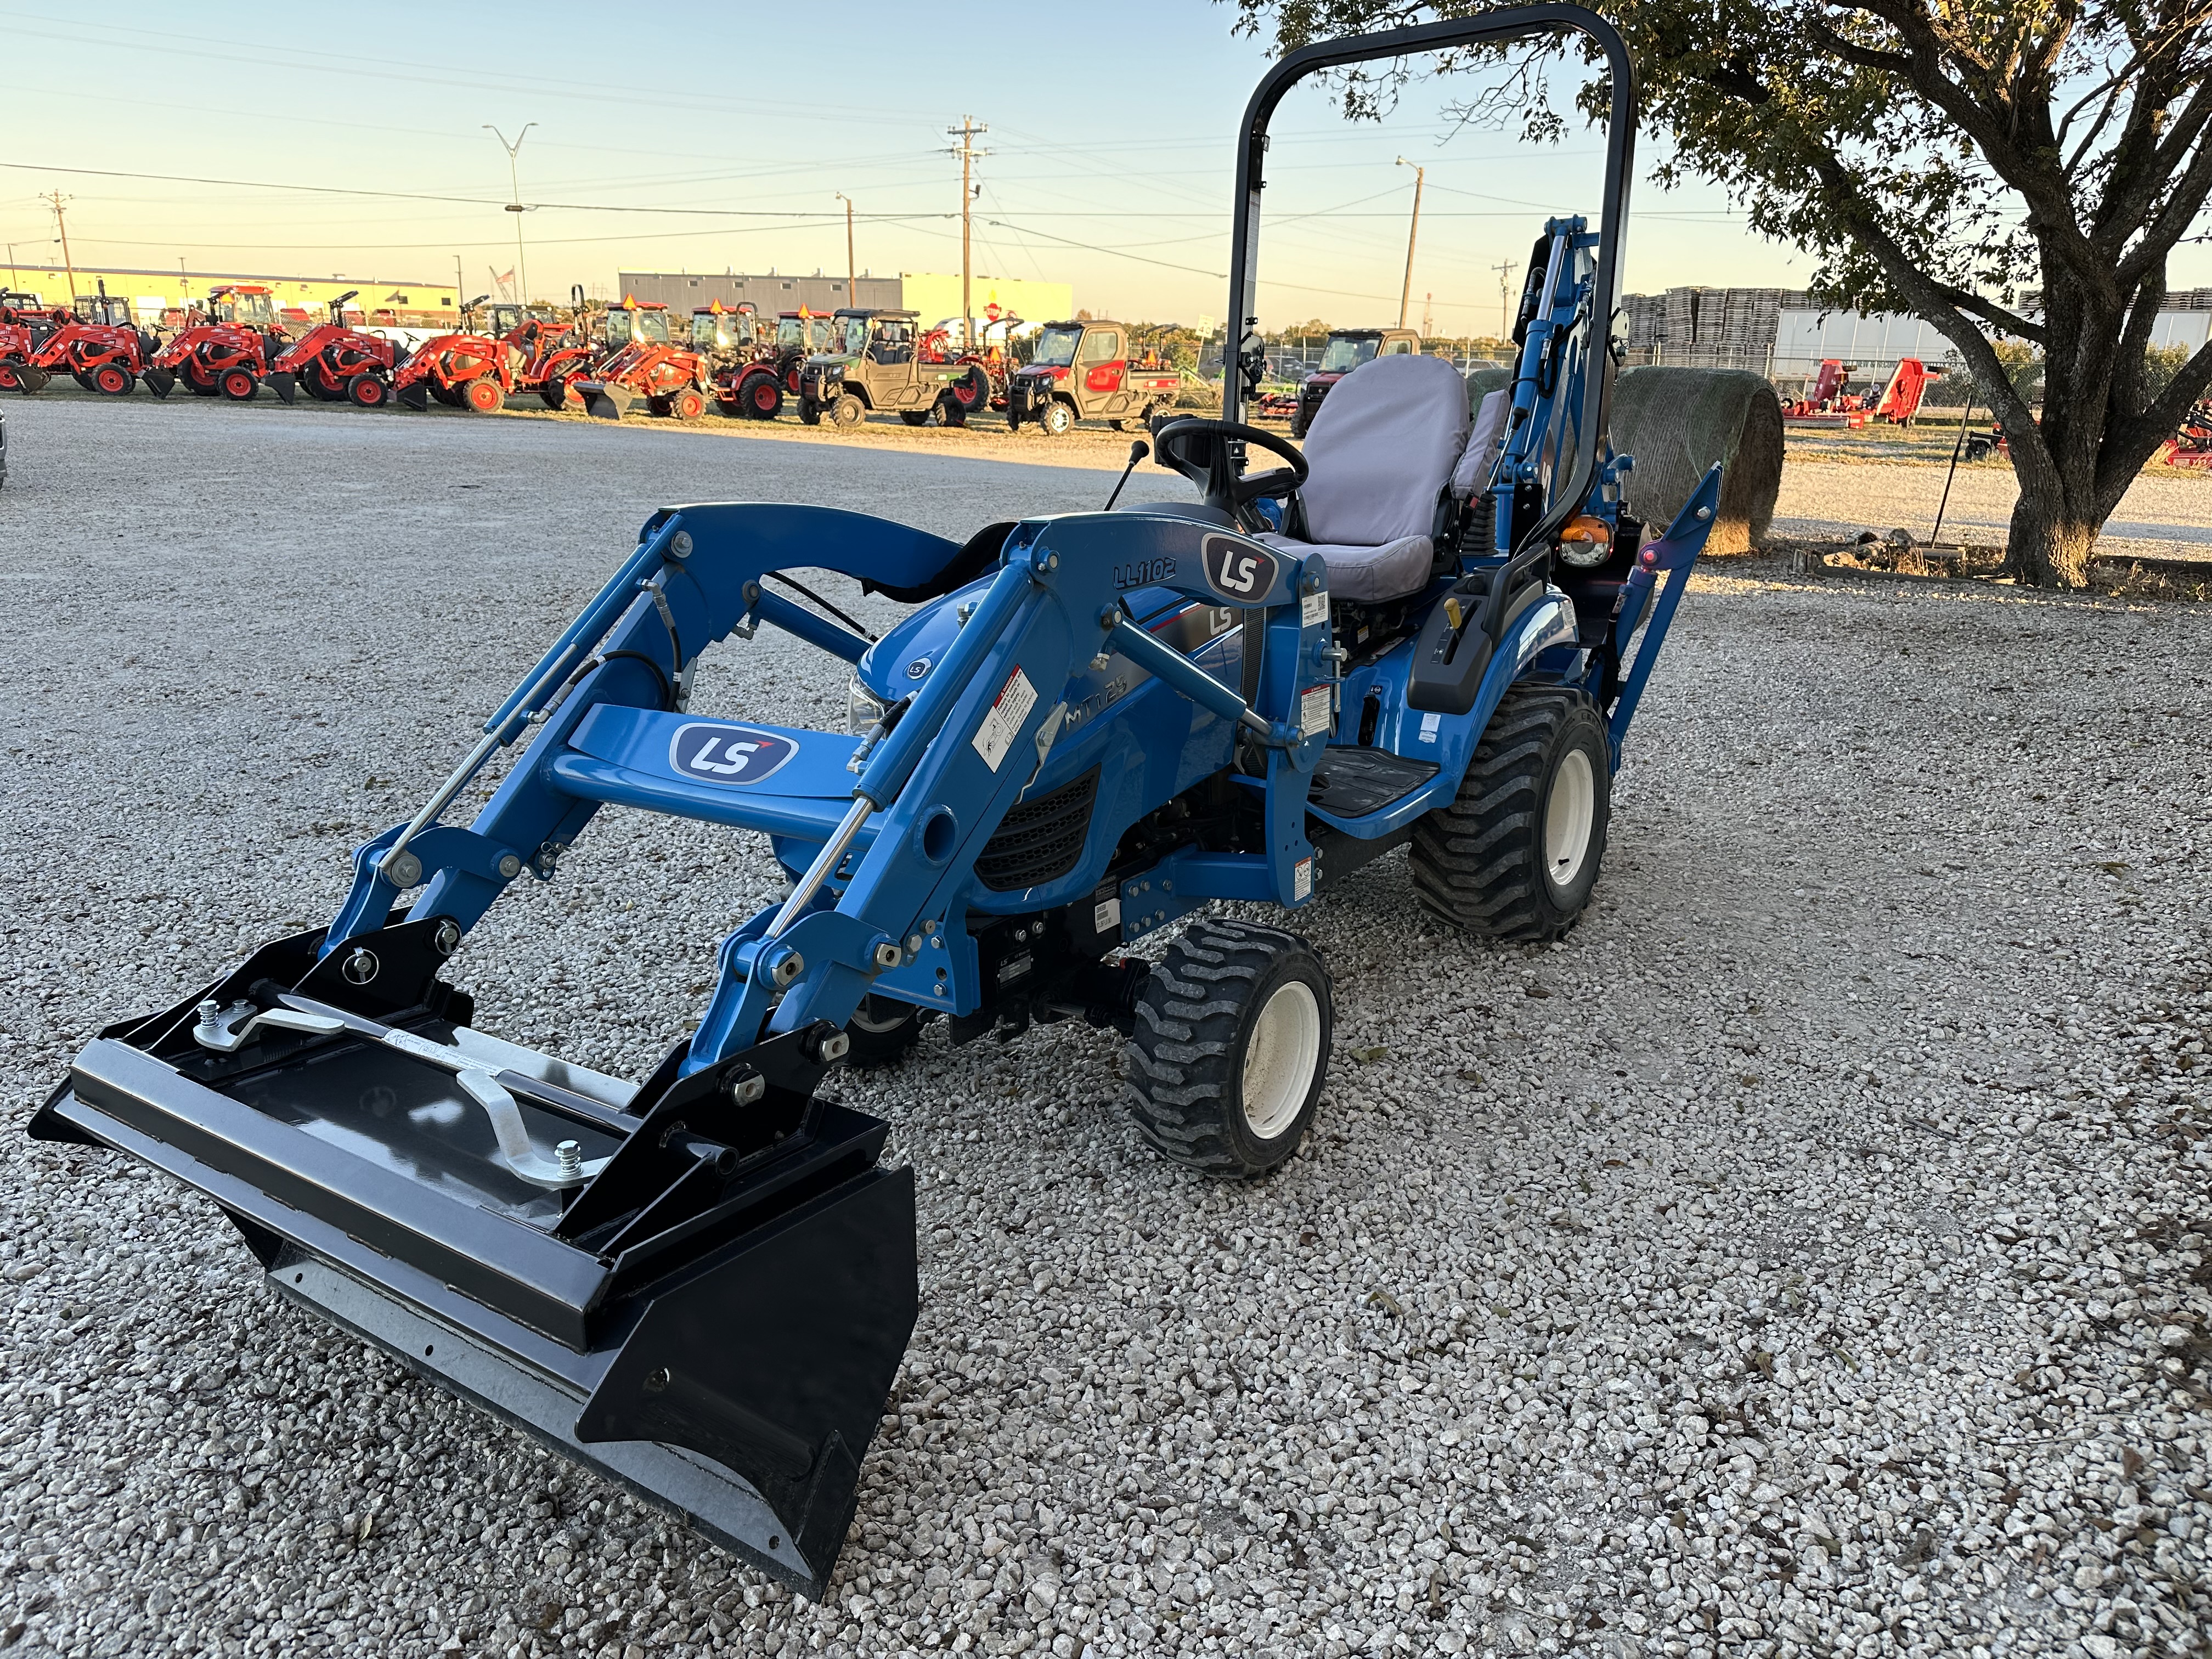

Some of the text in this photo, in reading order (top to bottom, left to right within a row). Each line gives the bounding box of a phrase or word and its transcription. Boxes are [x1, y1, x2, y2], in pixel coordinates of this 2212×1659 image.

[1199, 326, 1210, 334] 40
[1114, 557, 1176, 590] LL1102
[1220, 551, 1257, 592] LS
[1209, 607, 1232, 635] LS
[1003, 675, 1013, 692] DANGER
[690, 737, 760, 775] LS
[1001, 957, 1008, 967] LS
